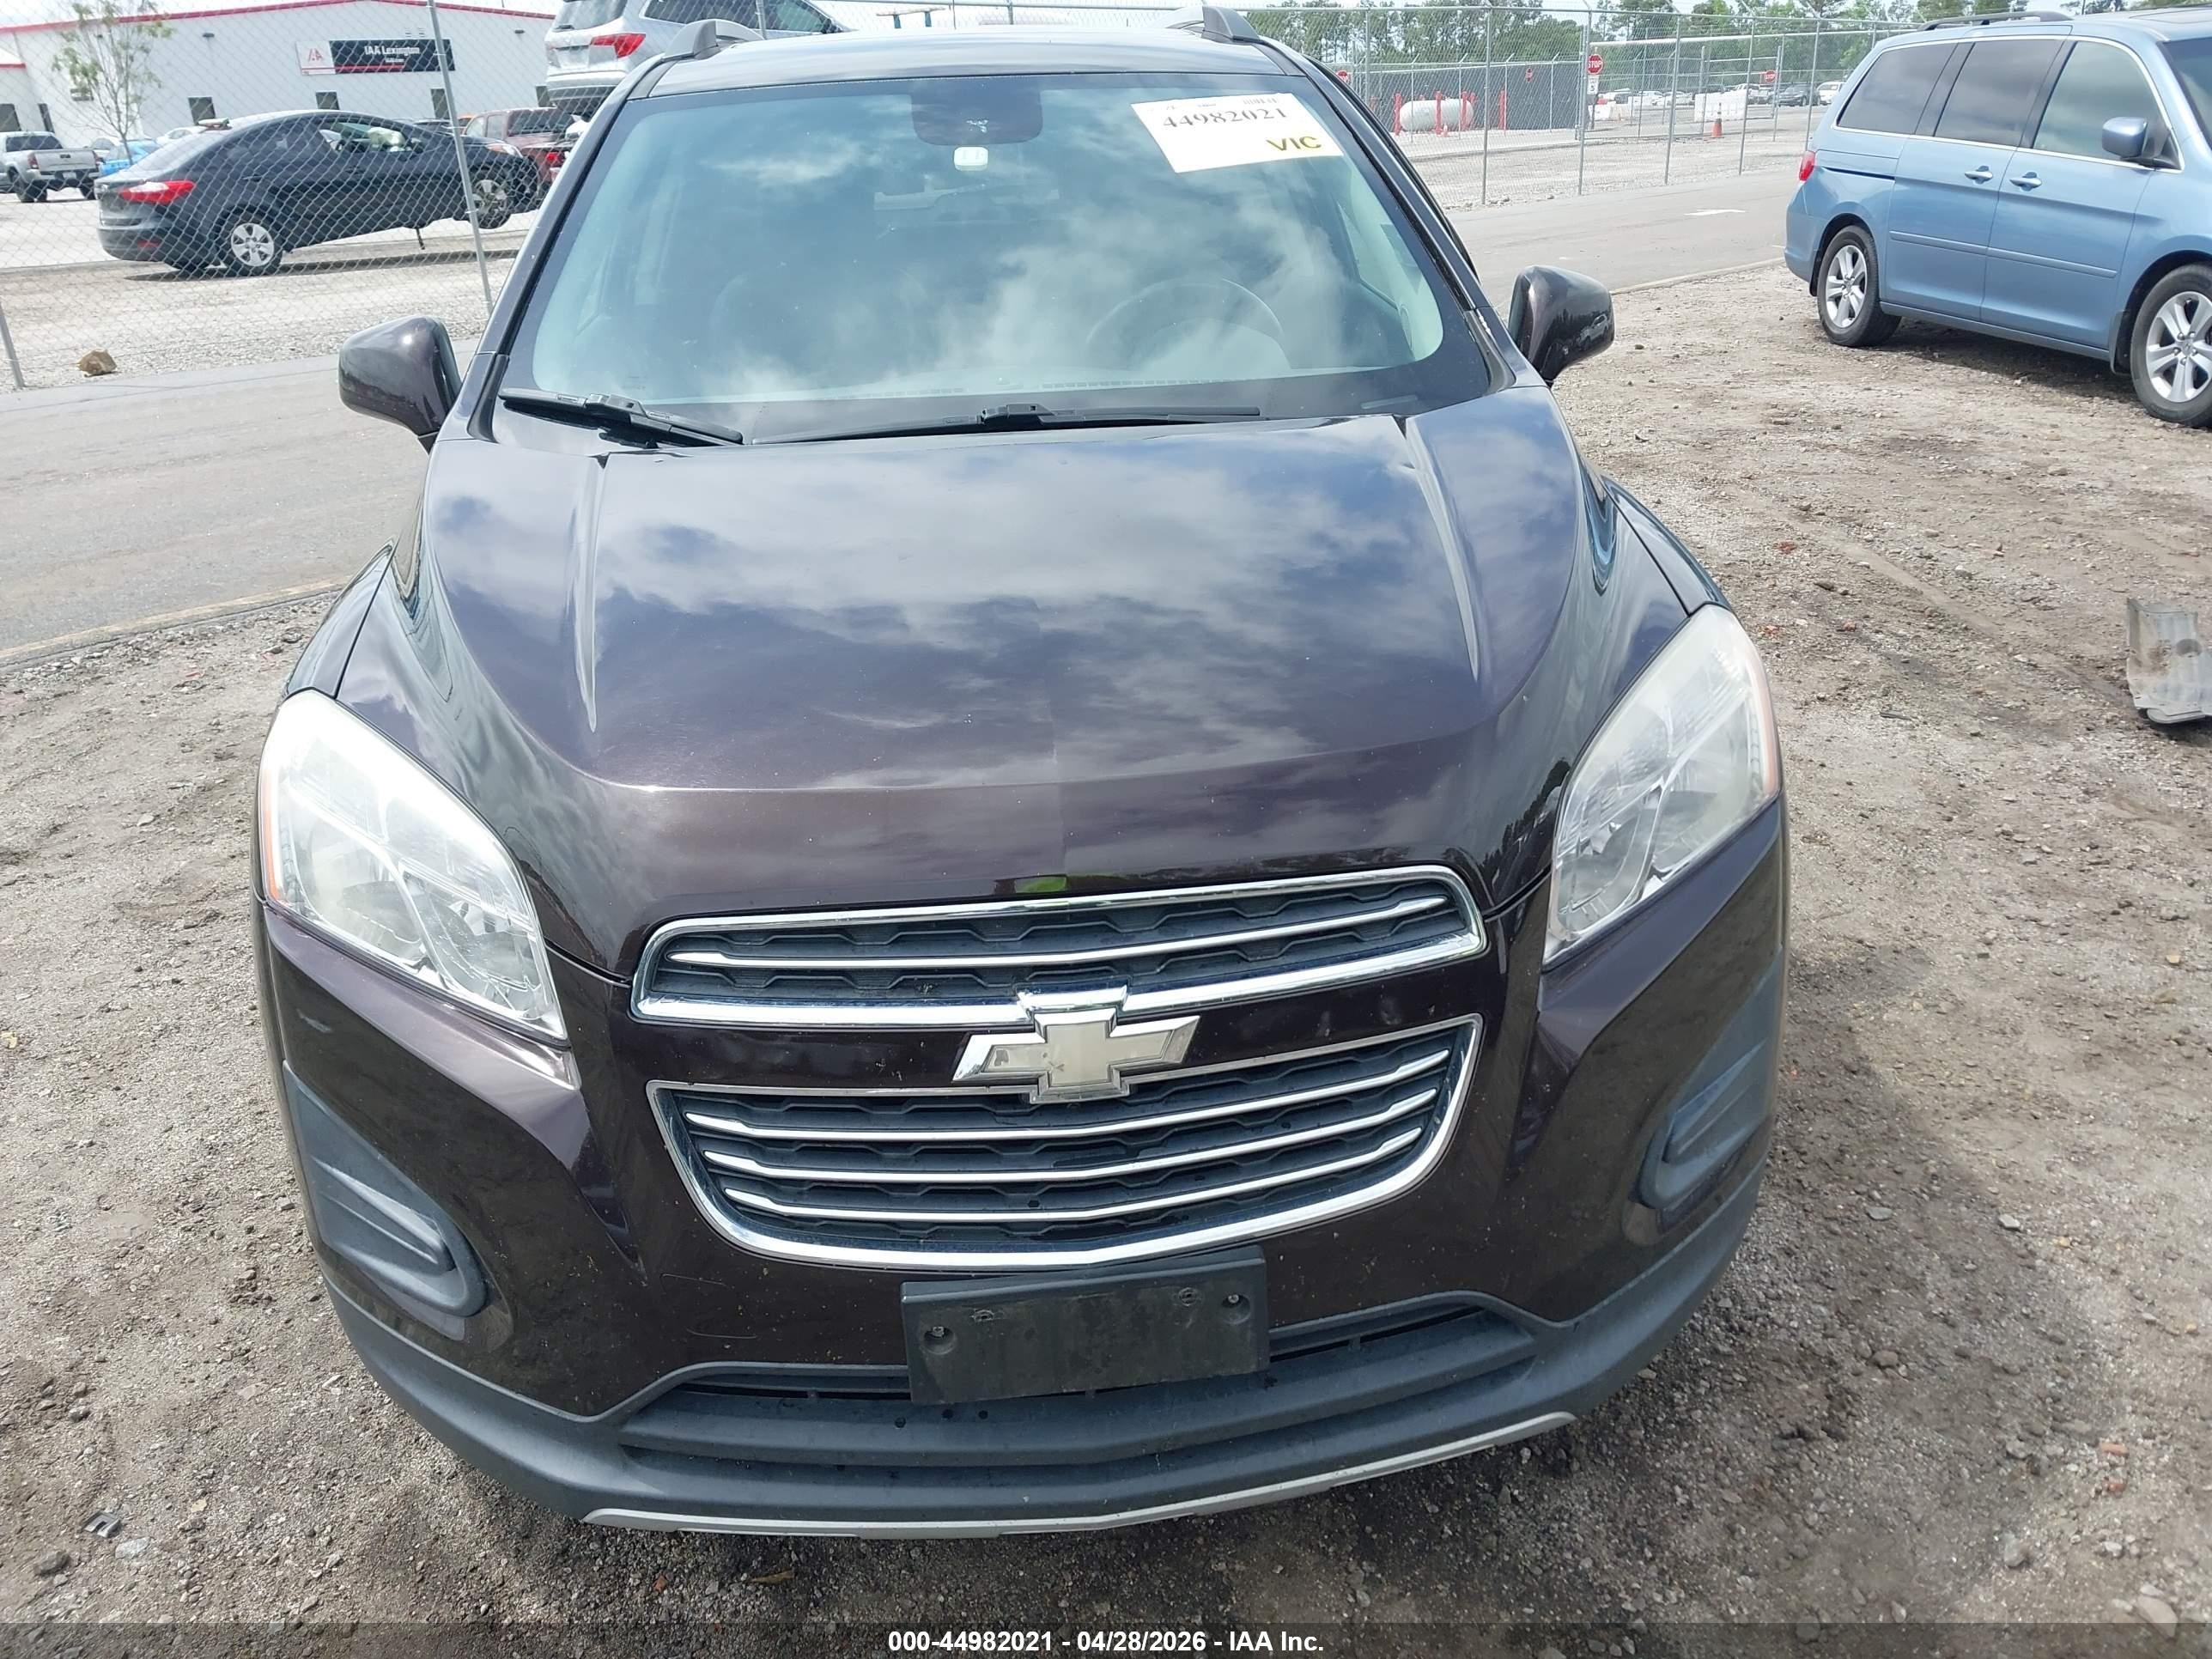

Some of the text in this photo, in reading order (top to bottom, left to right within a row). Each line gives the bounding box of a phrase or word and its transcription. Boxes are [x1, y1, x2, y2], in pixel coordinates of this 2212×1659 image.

[364, 46, 420, 56] IAA Lexington
[1589, 60, 1601, 69] STOP
[1163, 107, 1286, 128] 44982021
[1266, 137, 1322, 151] VIC
